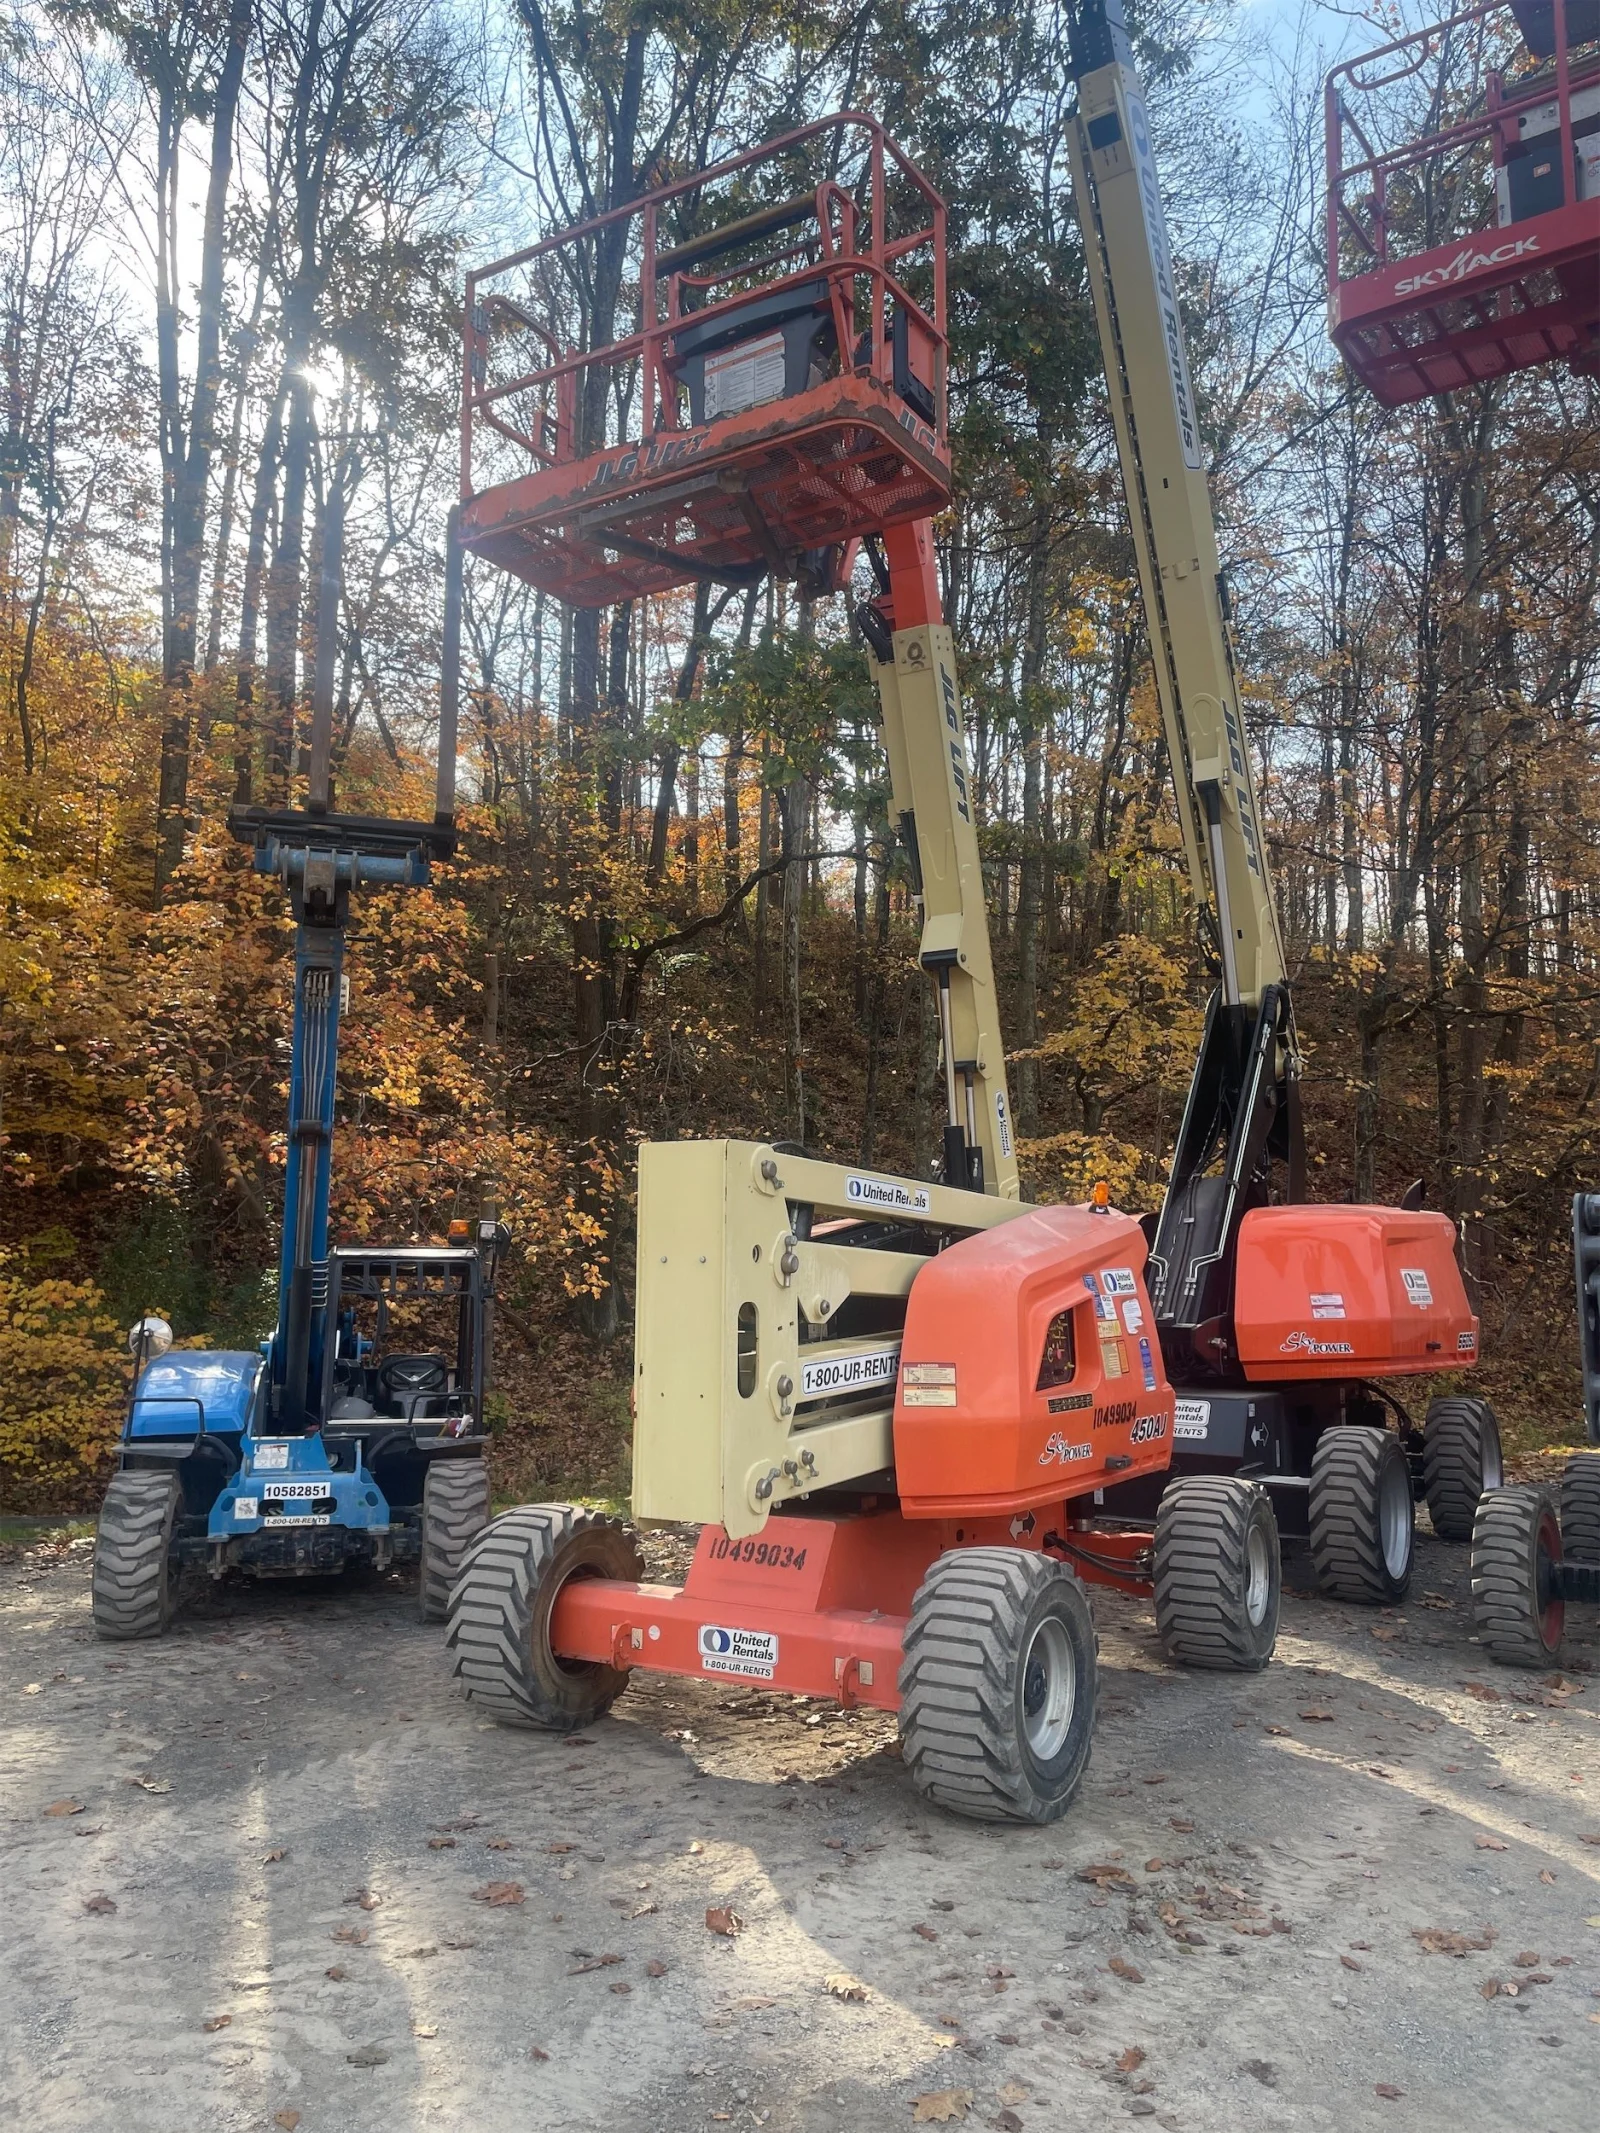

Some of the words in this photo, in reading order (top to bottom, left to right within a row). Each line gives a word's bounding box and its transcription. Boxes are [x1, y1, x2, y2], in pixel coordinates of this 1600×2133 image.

[1394, 235, 1541, 297] SKYJACK
[1141, 165, 1173, 300] United
[1164, 308, 1195, 450] Rentals
[939, 661, 959, 734] JLG
[949, 739, 970, 825] LIFT
[1221, 698, 1244, 778] JLG
[1236, 787, 1261, 878] LIFT
[863, 1183, 894, 1203] United
[895, 1189, 926, 1208] Renals
[1093, 1401, 1137, 1430] 10499034
[1175, 1404, 1202, 1413] nited
[1175, 1413, 1204, 1422] entals
[1130, 1412, 1168, 1444] 450AJ
[265, 1485, 328, 1497] 10582851
[266, 1516, 328, 1525] 1-800-UR-RENTS
[709, 1538, 807, 1571] 10499034
[732, 1645, 774, 1660] Rentals
[733, 1632, 771, 1648] United
[705, 1660, 771, 1677] 1-800-UR-RENTS
